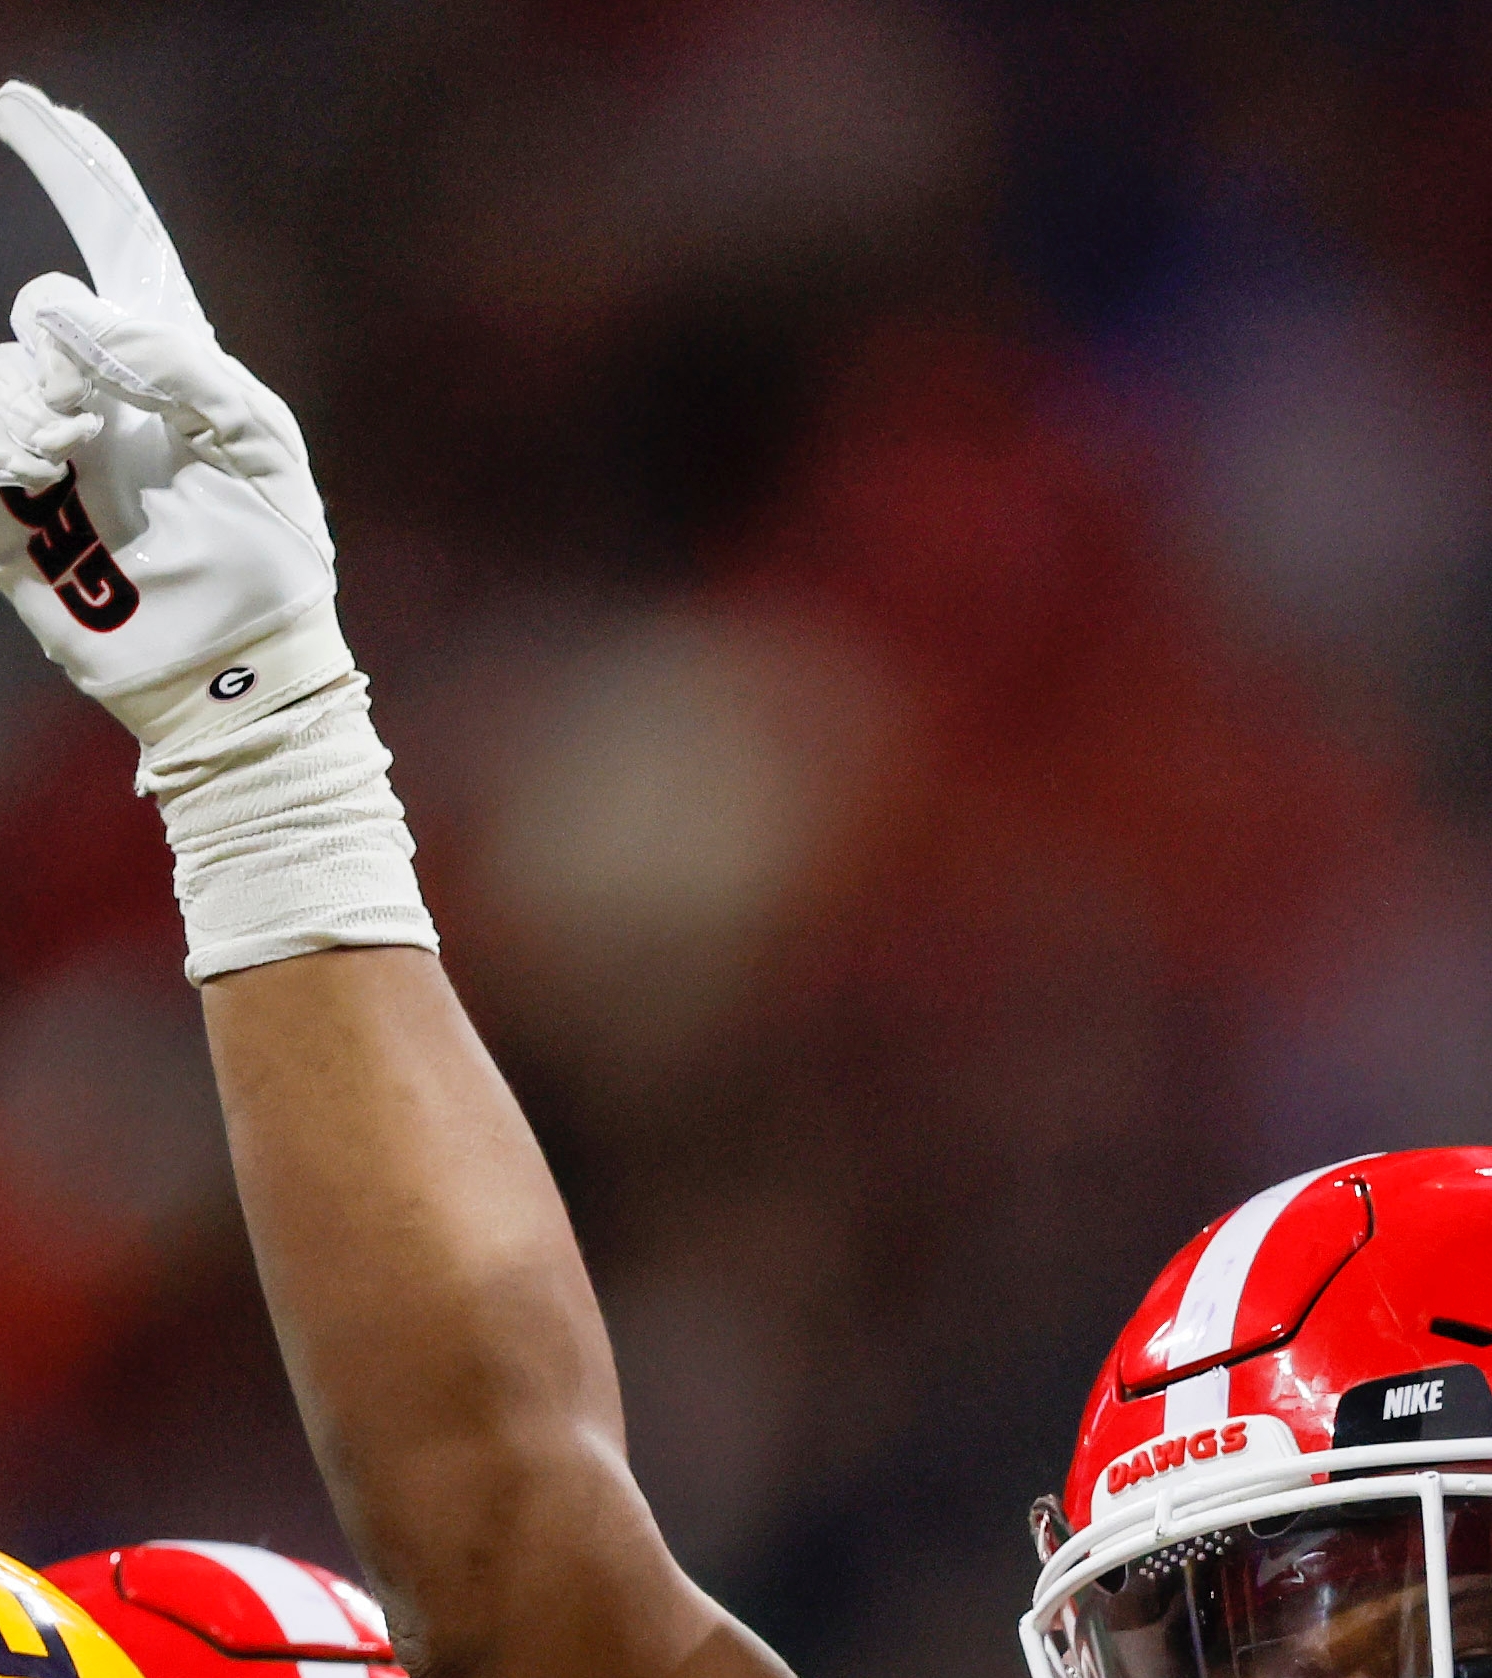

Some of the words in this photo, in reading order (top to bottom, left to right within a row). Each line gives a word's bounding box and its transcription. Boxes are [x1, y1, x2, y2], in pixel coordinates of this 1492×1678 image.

[210, 667, 256, 699] G
[1382, 1378, 1445, 1421] NIKE
[1106, 1420, 1249, 1495] DAWGS
